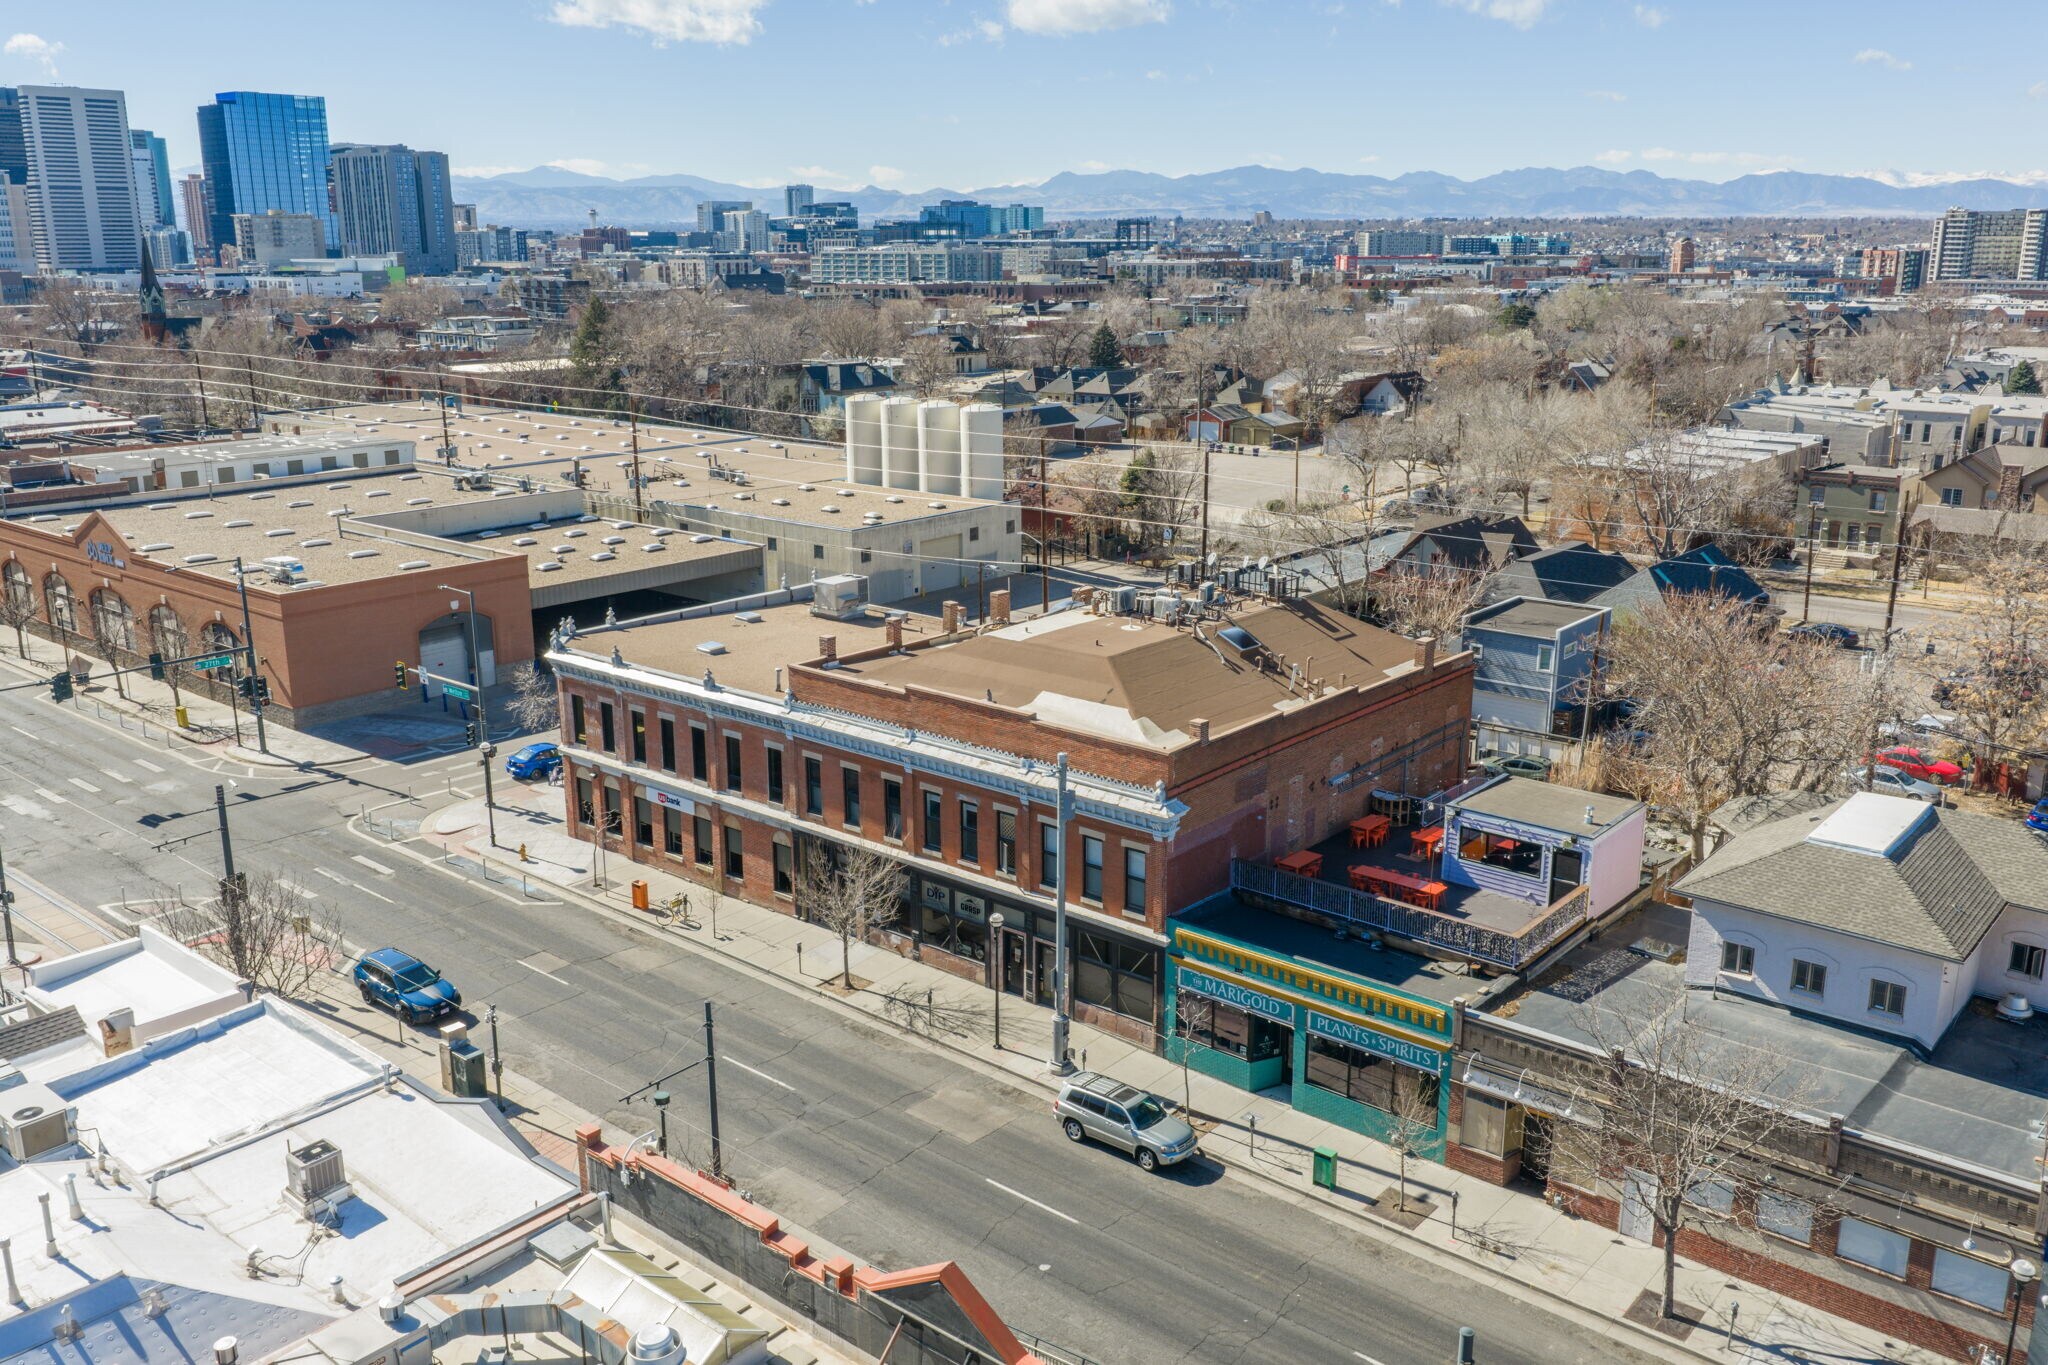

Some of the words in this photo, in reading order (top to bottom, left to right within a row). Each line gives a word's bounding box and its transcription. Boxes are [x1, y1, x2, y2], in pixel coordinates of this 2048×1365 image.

[204, 659, 220, 668] 27th
[960, 902, 981, 916] GRASP
[1192, 977, 1203, 987] THE
[1204, 979, 1280, 1014] MARIGOLD
[1316, 1018, 1369, 1045] PLANTS
[1378, 1037, 1432, 1065] SPIRITS
